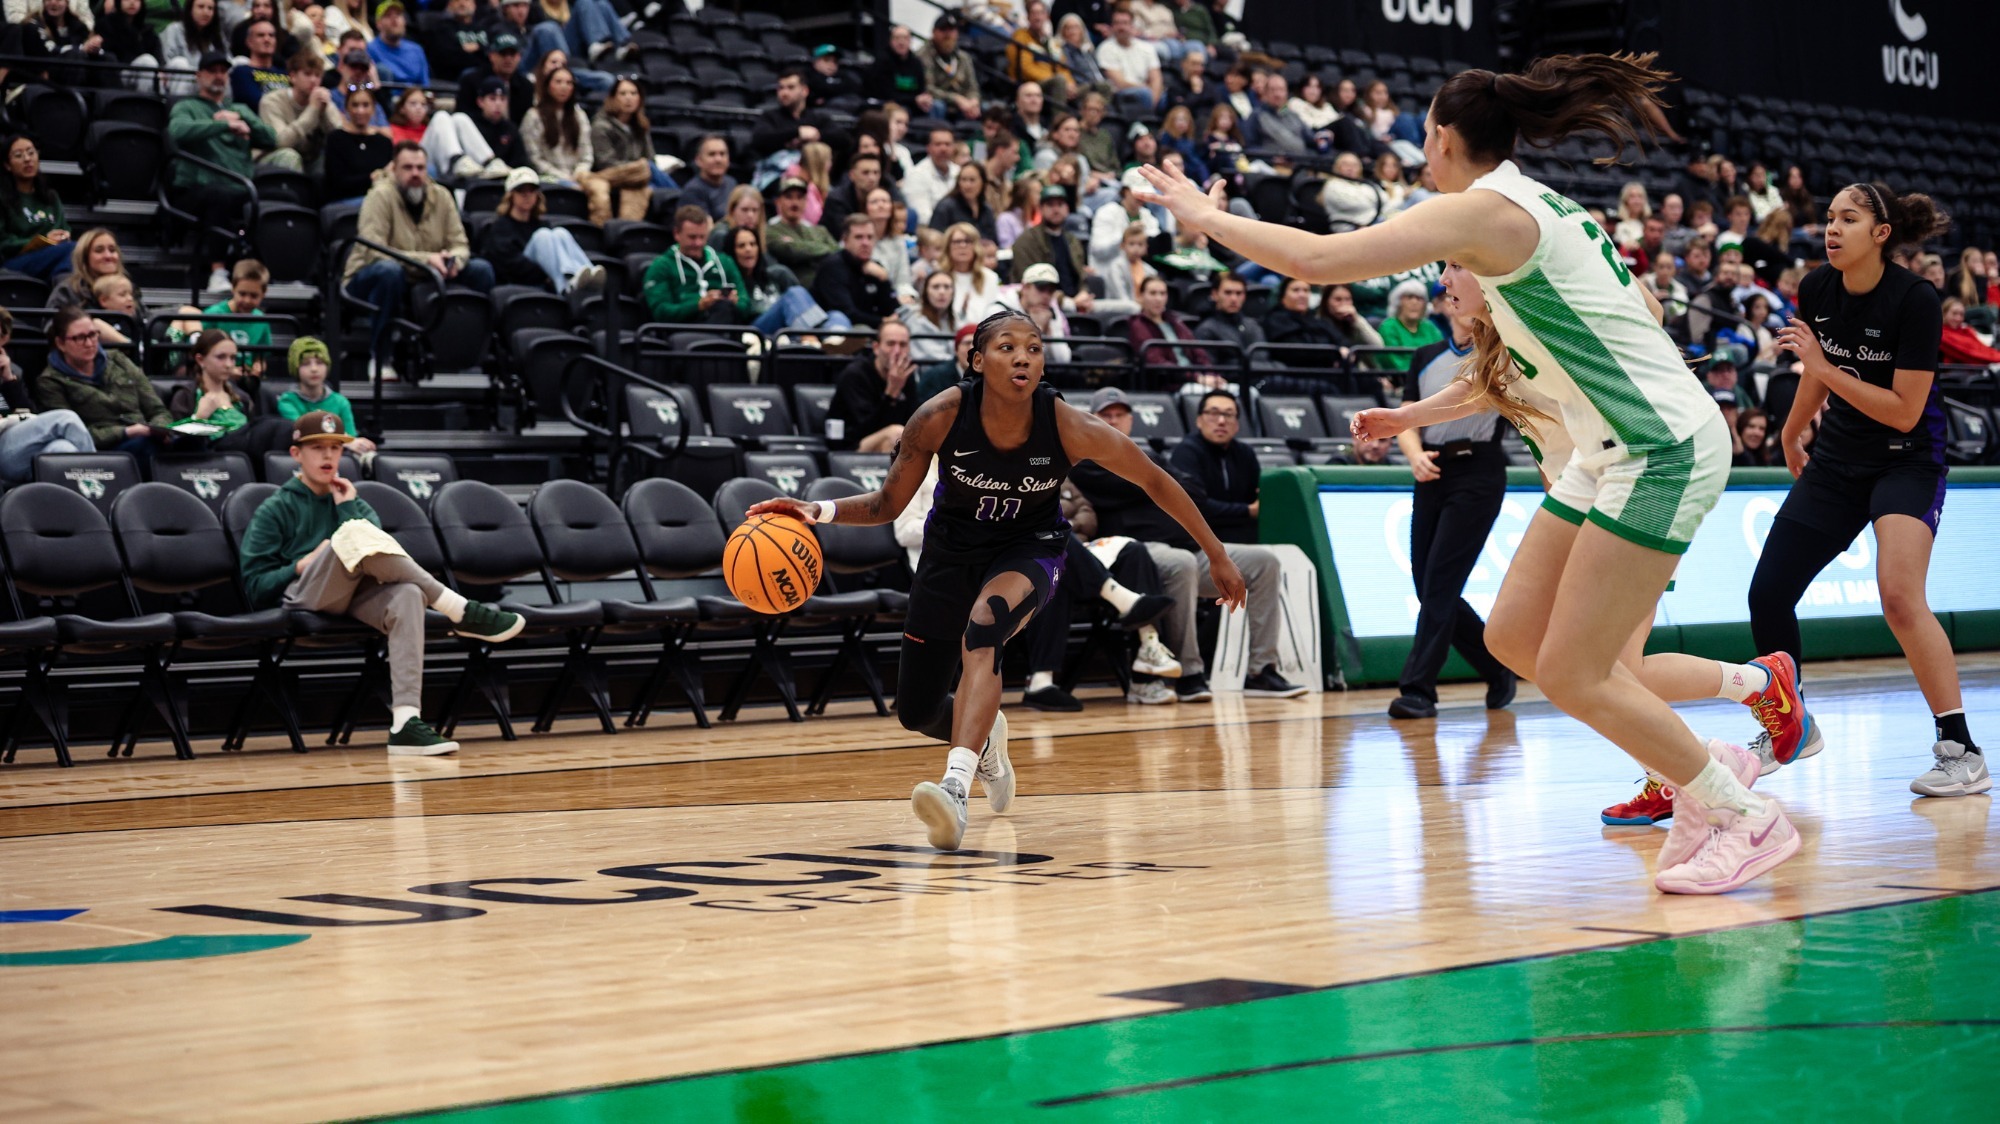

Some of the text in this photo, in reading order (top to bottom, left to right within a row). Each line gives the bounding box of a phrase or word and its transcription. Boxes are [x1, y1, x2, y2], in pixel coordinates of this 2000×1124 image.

[1882, 45, 1939, 90] UCCU
[1818, 331, 1893, 361] leton State
[1029, 457, 1051, 466] WAC
[951, 465, 1058, 492] Tarleton State
[975, 495, 1021, 521] 11
[772, 568, 801, 607] NCAA
[1797, 581, 1843, 607] TEIN
[151, 843, 1056, 928] UCCU
[688, 861, 1211, 913] CENTER
